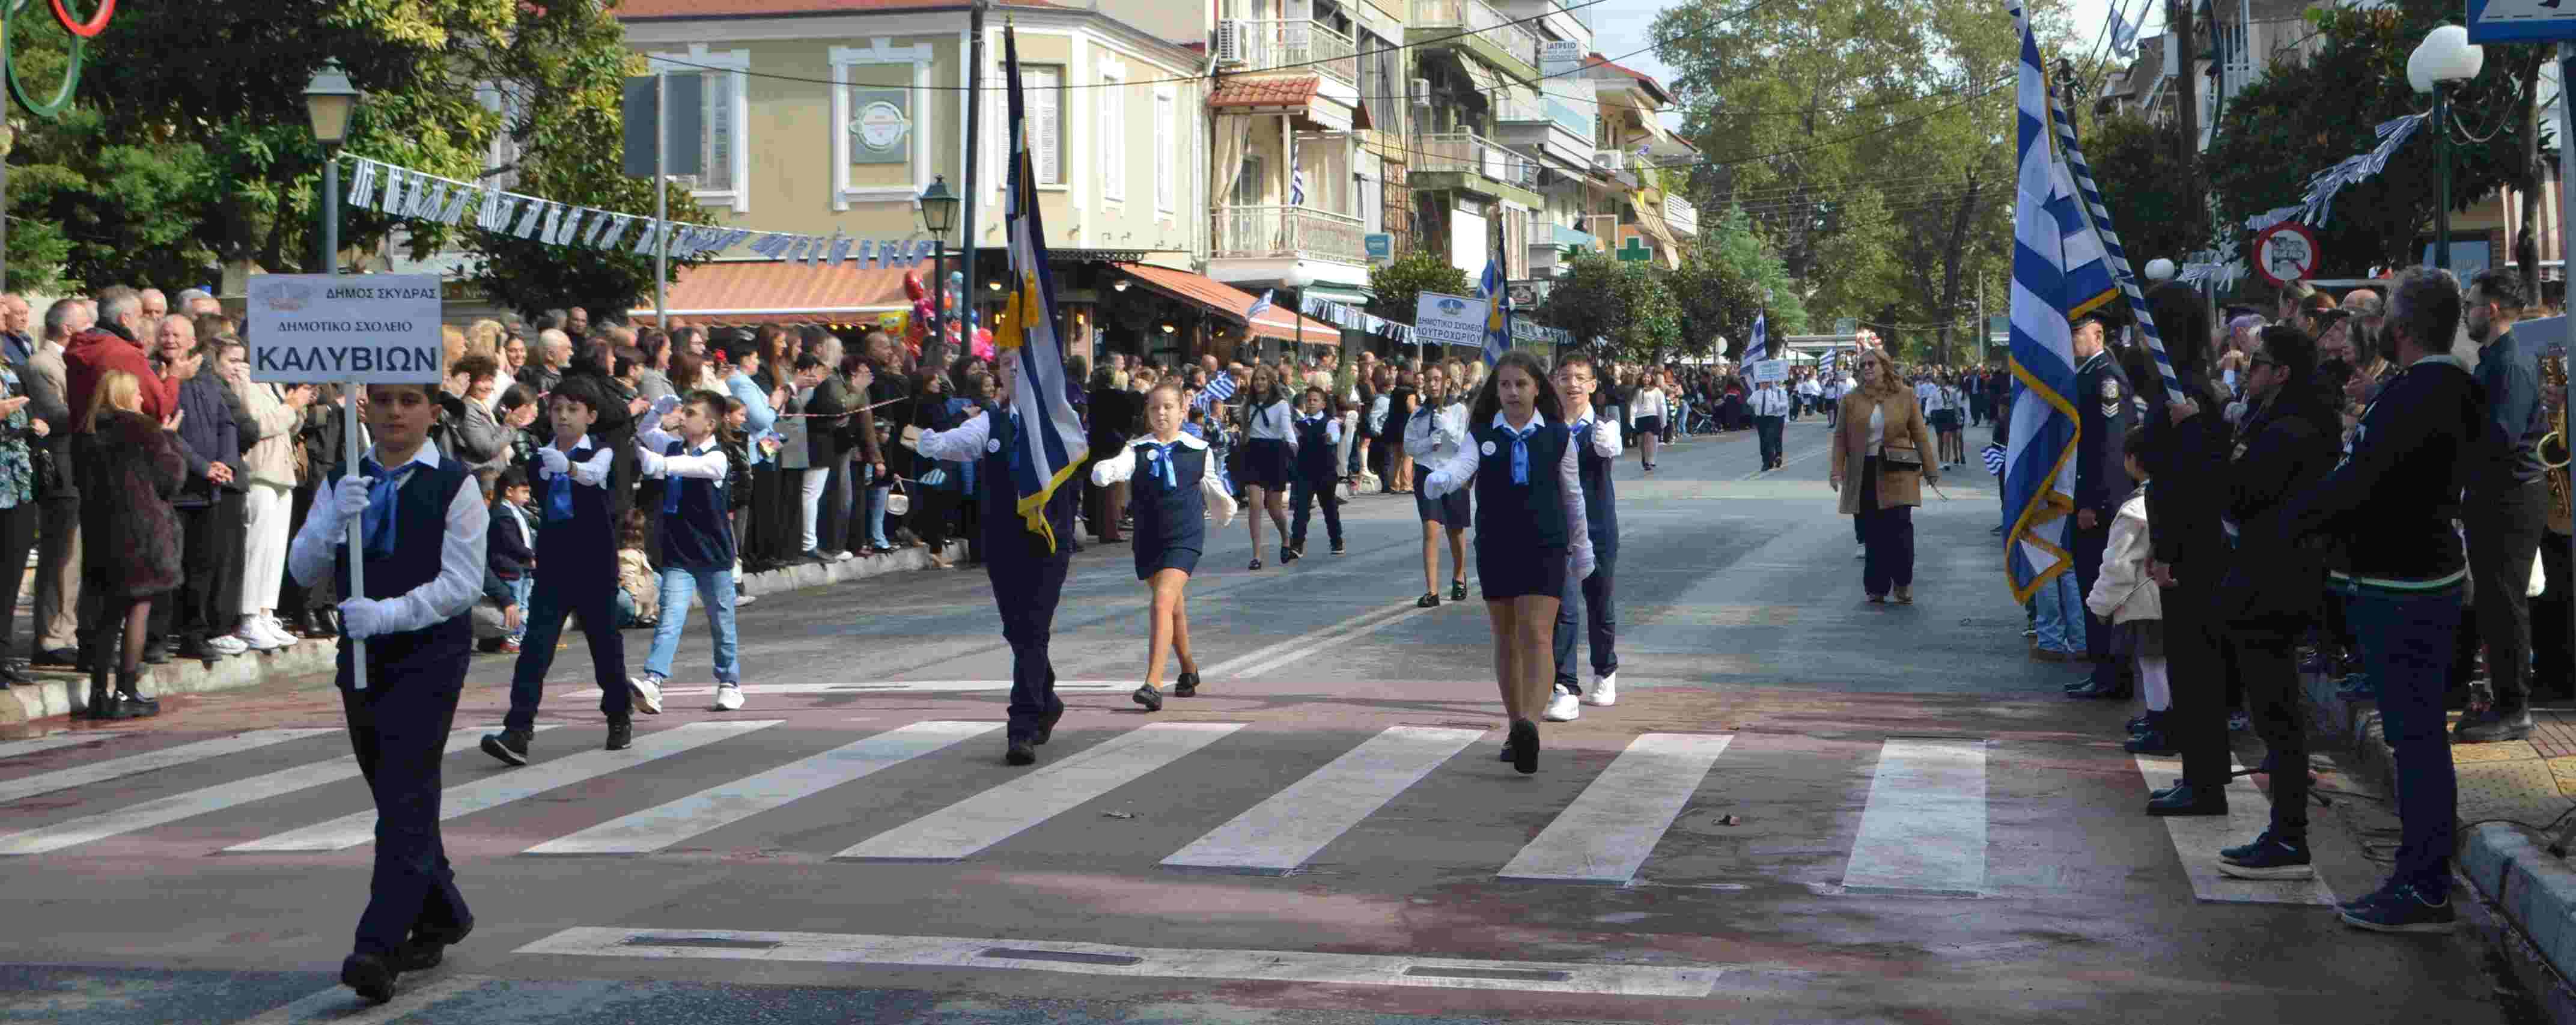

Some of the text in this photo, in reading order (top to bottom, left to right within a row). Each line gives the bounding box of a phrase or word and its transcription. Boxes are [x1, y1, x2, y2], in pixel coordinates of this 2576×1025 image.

[326, 288, 374, 299] ΔΗΜΟΣ
[377, 287, 437, 300] ΣΚΥΔΡΑΣ
[278, 321, 413, 332] ΔΗΜΟΤΙΚΟ ΣΧΟΛΕΙΟ
[1417, 317, 1482, 332] ΔΗΜΟΤΙΚΟ ΣΧΟΛΕΙΟ
[1416, 326, 1481, 342] ΛΟΥΤΡΟΧΩΡΙΟΥ
[257, 346, 437, 372] ΚΑΛΥΒΙΩΝ
